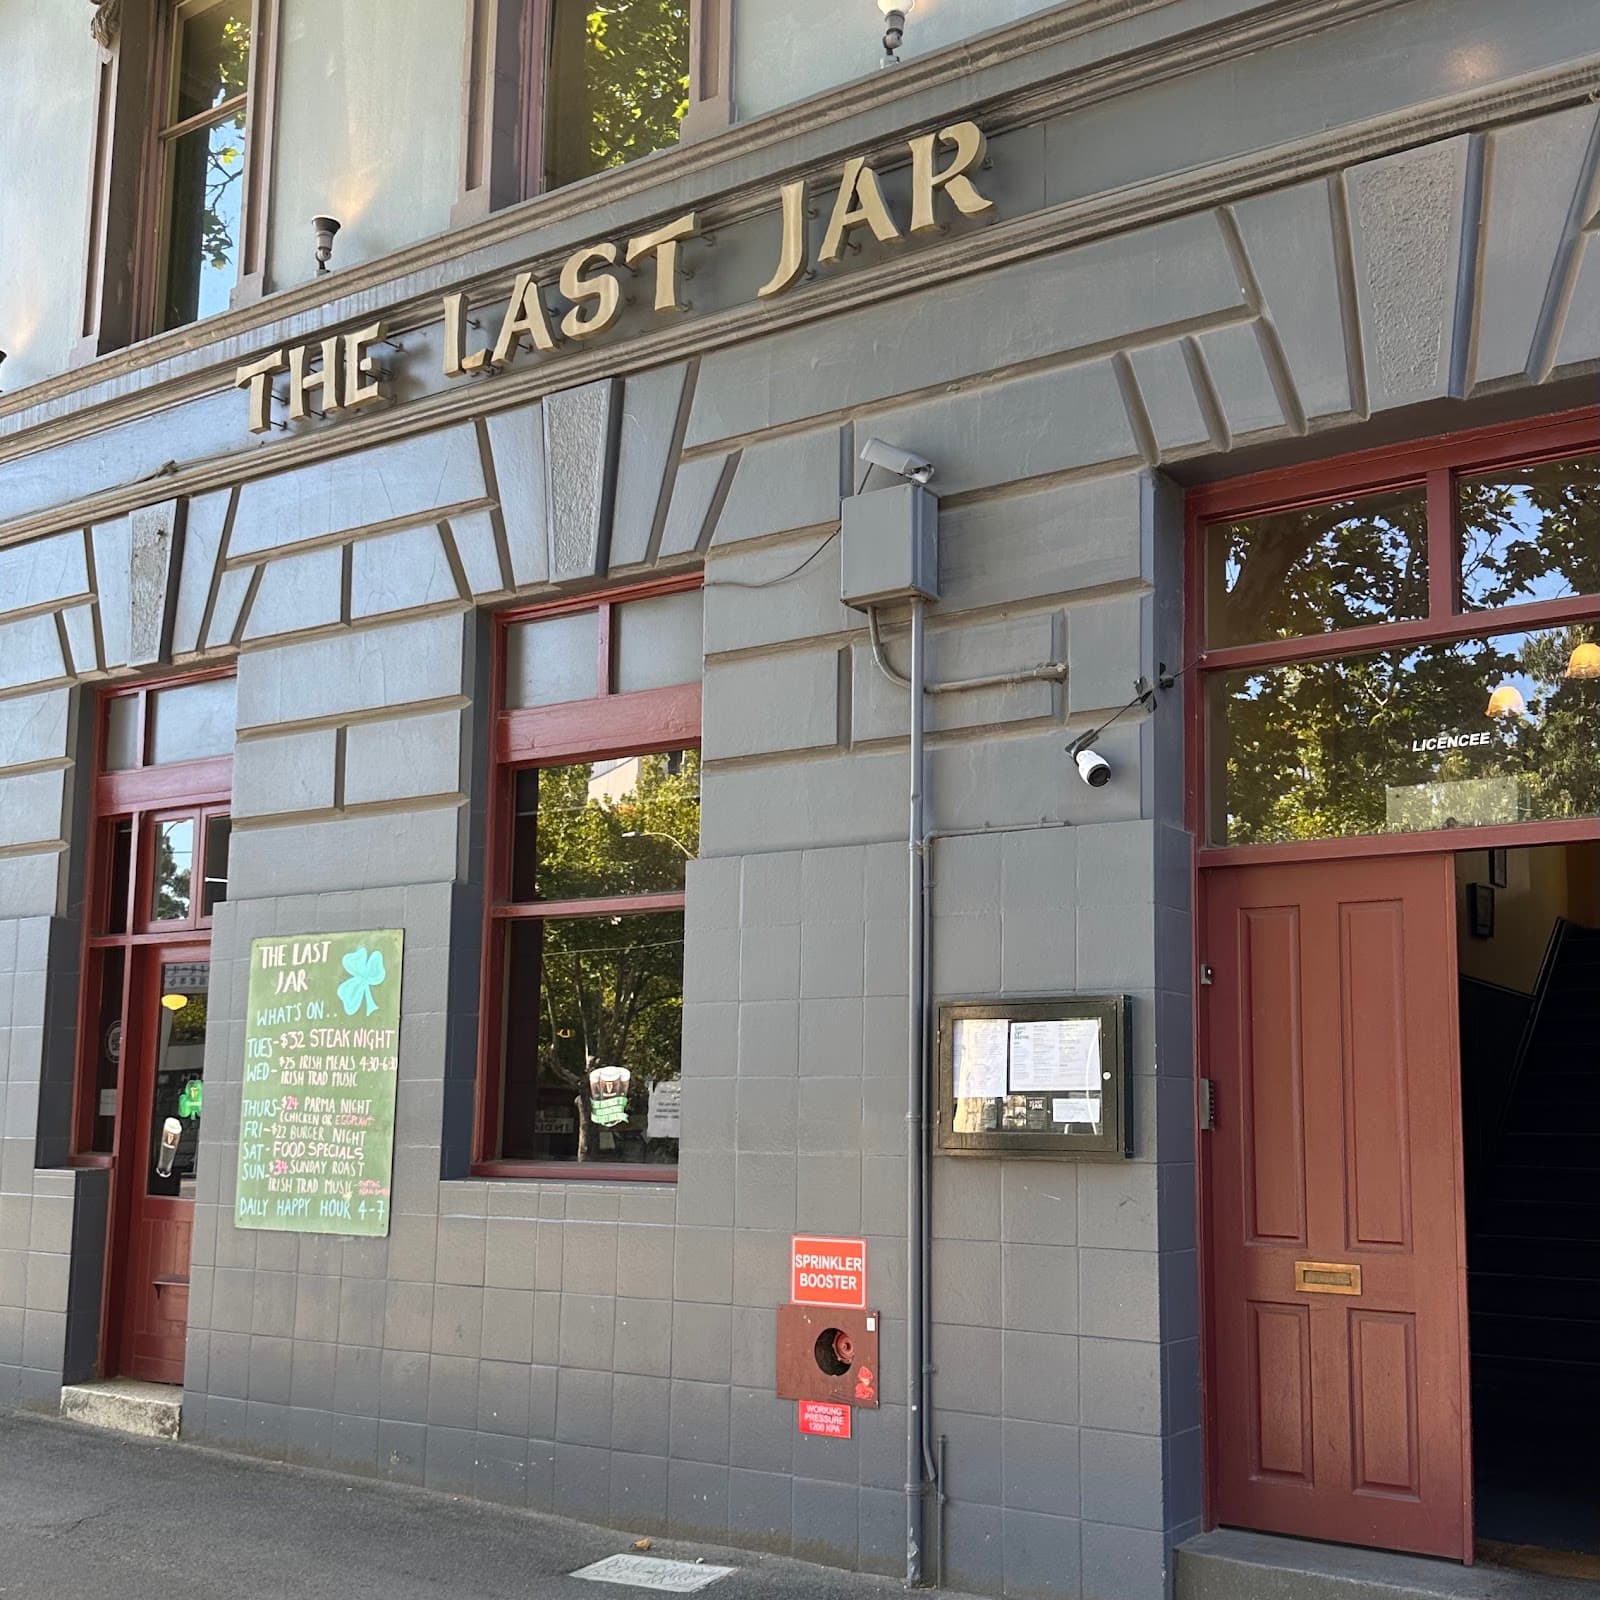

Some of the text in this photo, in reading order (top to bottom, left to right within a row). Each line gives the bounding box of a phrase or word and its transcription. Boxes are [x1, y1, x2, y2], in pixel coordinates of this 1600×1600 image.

[235, 120, 994, 433] THE LAST JAR
[1412, 732, 1491, 752] LICENCEE
[259, 941, 332, 968] THE LAST
[274, 969, 309, 995] JAR
[256, 1003, 302, 1026] WHAT'S
[310, 1029, 350, 1048] STEAK
[353, 1028, 395, 1050] NIGHT
[299, 1055, 322, 1069] IRISH
[325, 1056, 355, 1071] MEALS
[280, 1071, 358, 1087] IRISH TRAD MUSIC
[304, 1096, 336, 1113] PARMA
[340, 1099, 372, 1115] NIGHT
[321, 1114, 333, 1126] OR
[290, 1125, 324, 1141] BURGER
[332, 1127, 367, 1146] NIGHT
[272, 1141, 306, 1158] FOOD
[308, 1142, 364, 1160] SPECIALS
[289, 1160, 327, 1176] SUNDAY
[332, 1162, 365, 1177] ROAST
[268, 1178, 293, 1193] IRISH
[296, 1178, 319, 1194] TRAD
[324, 1179, 353, 1194] MUSIC
[240, 1198, 269, 1216] DAILY
[277, 1198, 311, 1217] HAPPY
[320, 1199, 351, 1219] HOUR
[795, 1254, 862, 1272] SPRINKLER
[800, 1273, 857, 1290] BOOSTER
[804, 1413, 844, 1425] PRESSURE
[806, 1404, 842, 1416] WORKING
